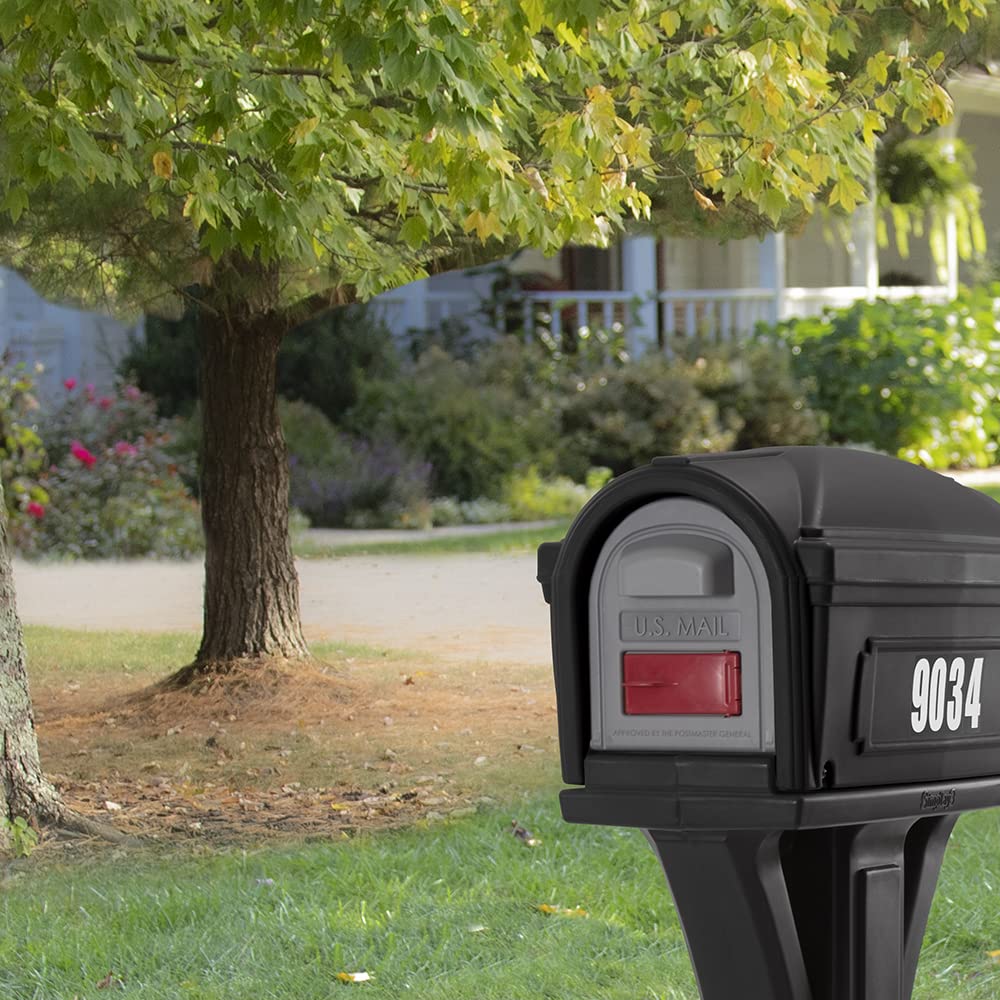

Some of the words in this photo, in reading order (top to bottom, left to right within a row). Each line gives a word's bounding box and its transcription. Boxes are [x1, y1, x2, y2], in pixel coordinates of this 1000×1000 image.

[634, 616, 671, 637] U.S.
[677, 616, 730, 637] MAIL
[911, 657, 985, 734] 9034
[612, 729, 650, 737] APPROVED
[662, 729, 673, 737] THE
[674, 729, 717, 738] POSTMASTER
[719, 729, 752, 738] GENERAL
